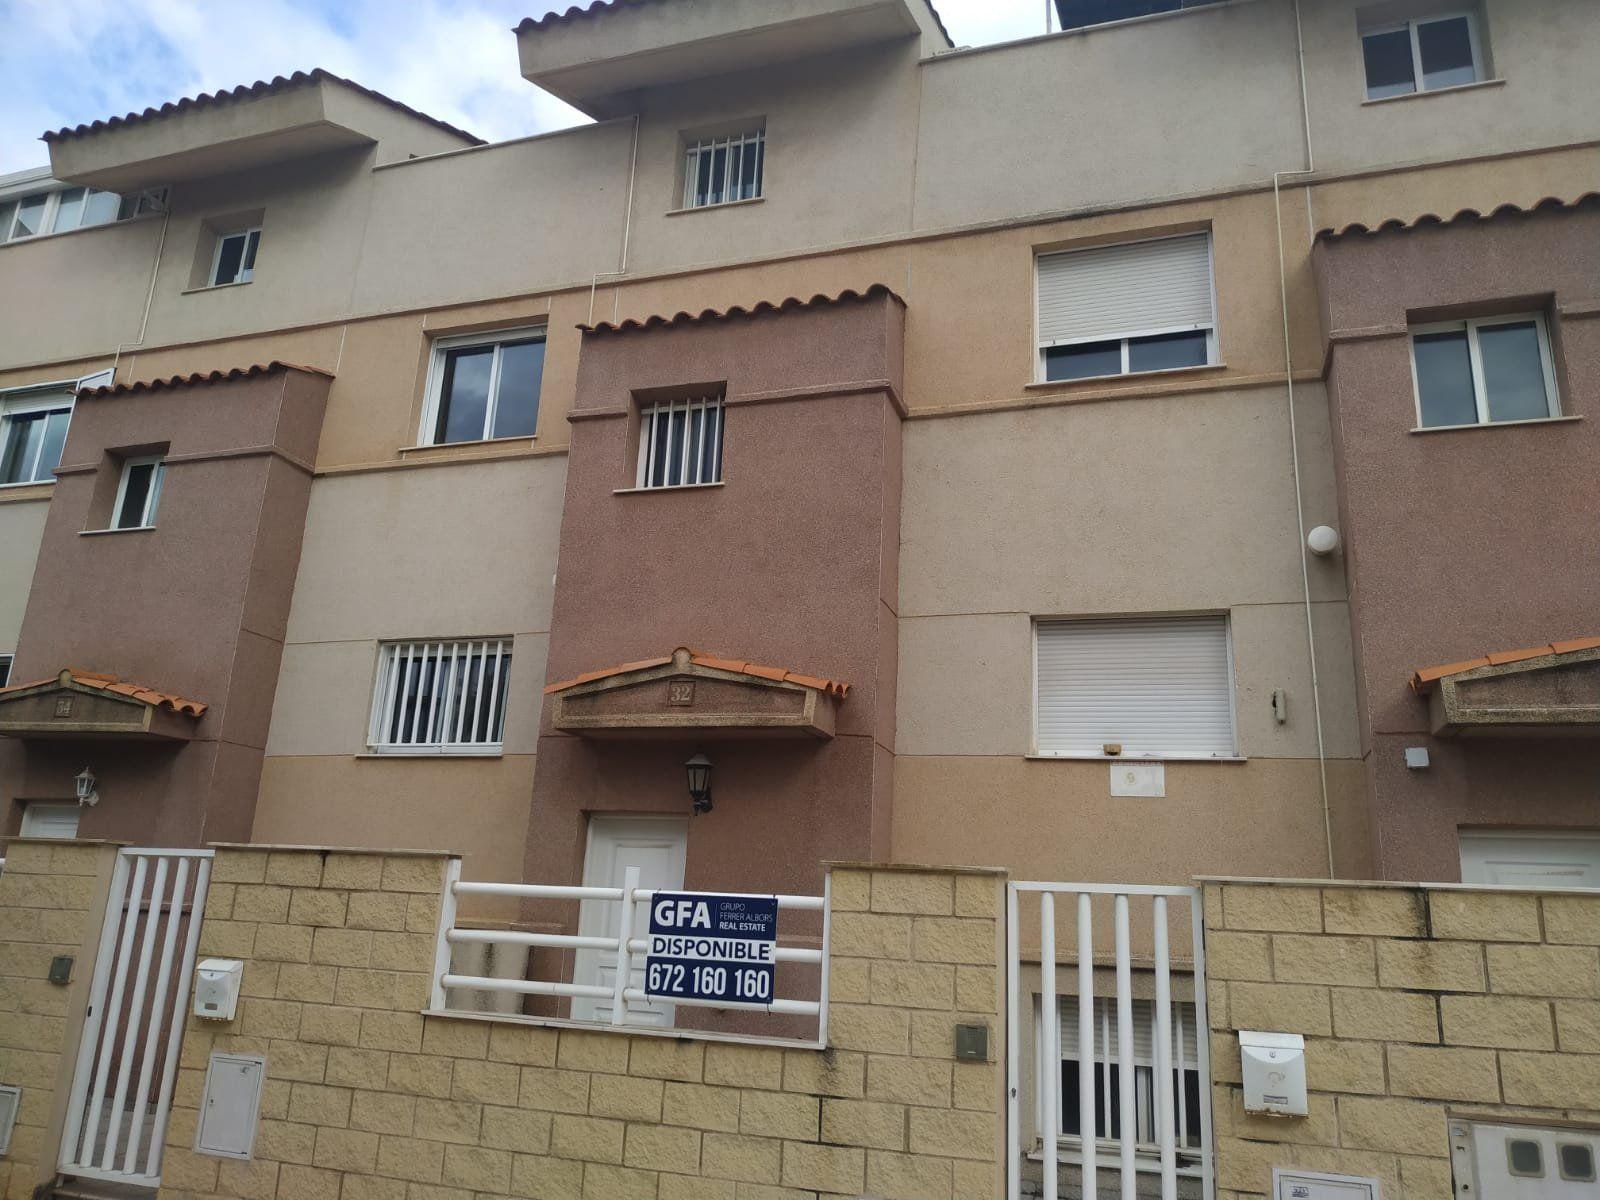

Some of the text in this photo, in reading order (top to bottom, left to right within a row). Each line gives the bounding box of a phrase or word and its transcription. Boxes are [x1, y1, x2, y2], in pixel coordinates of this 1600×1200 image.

[670, 686, 690, 702] 32
[654, 900, 711, 929] GFA
[720, 902, 746, 911] GRUPO
[719, 911, 773, 922] FERRER ALBORS
[719, 921, 766, 932] REAL ESTATE
[652, 937, 770, 961] DISPONIBLE
[649, 963, 770, 999] 672 160 160
